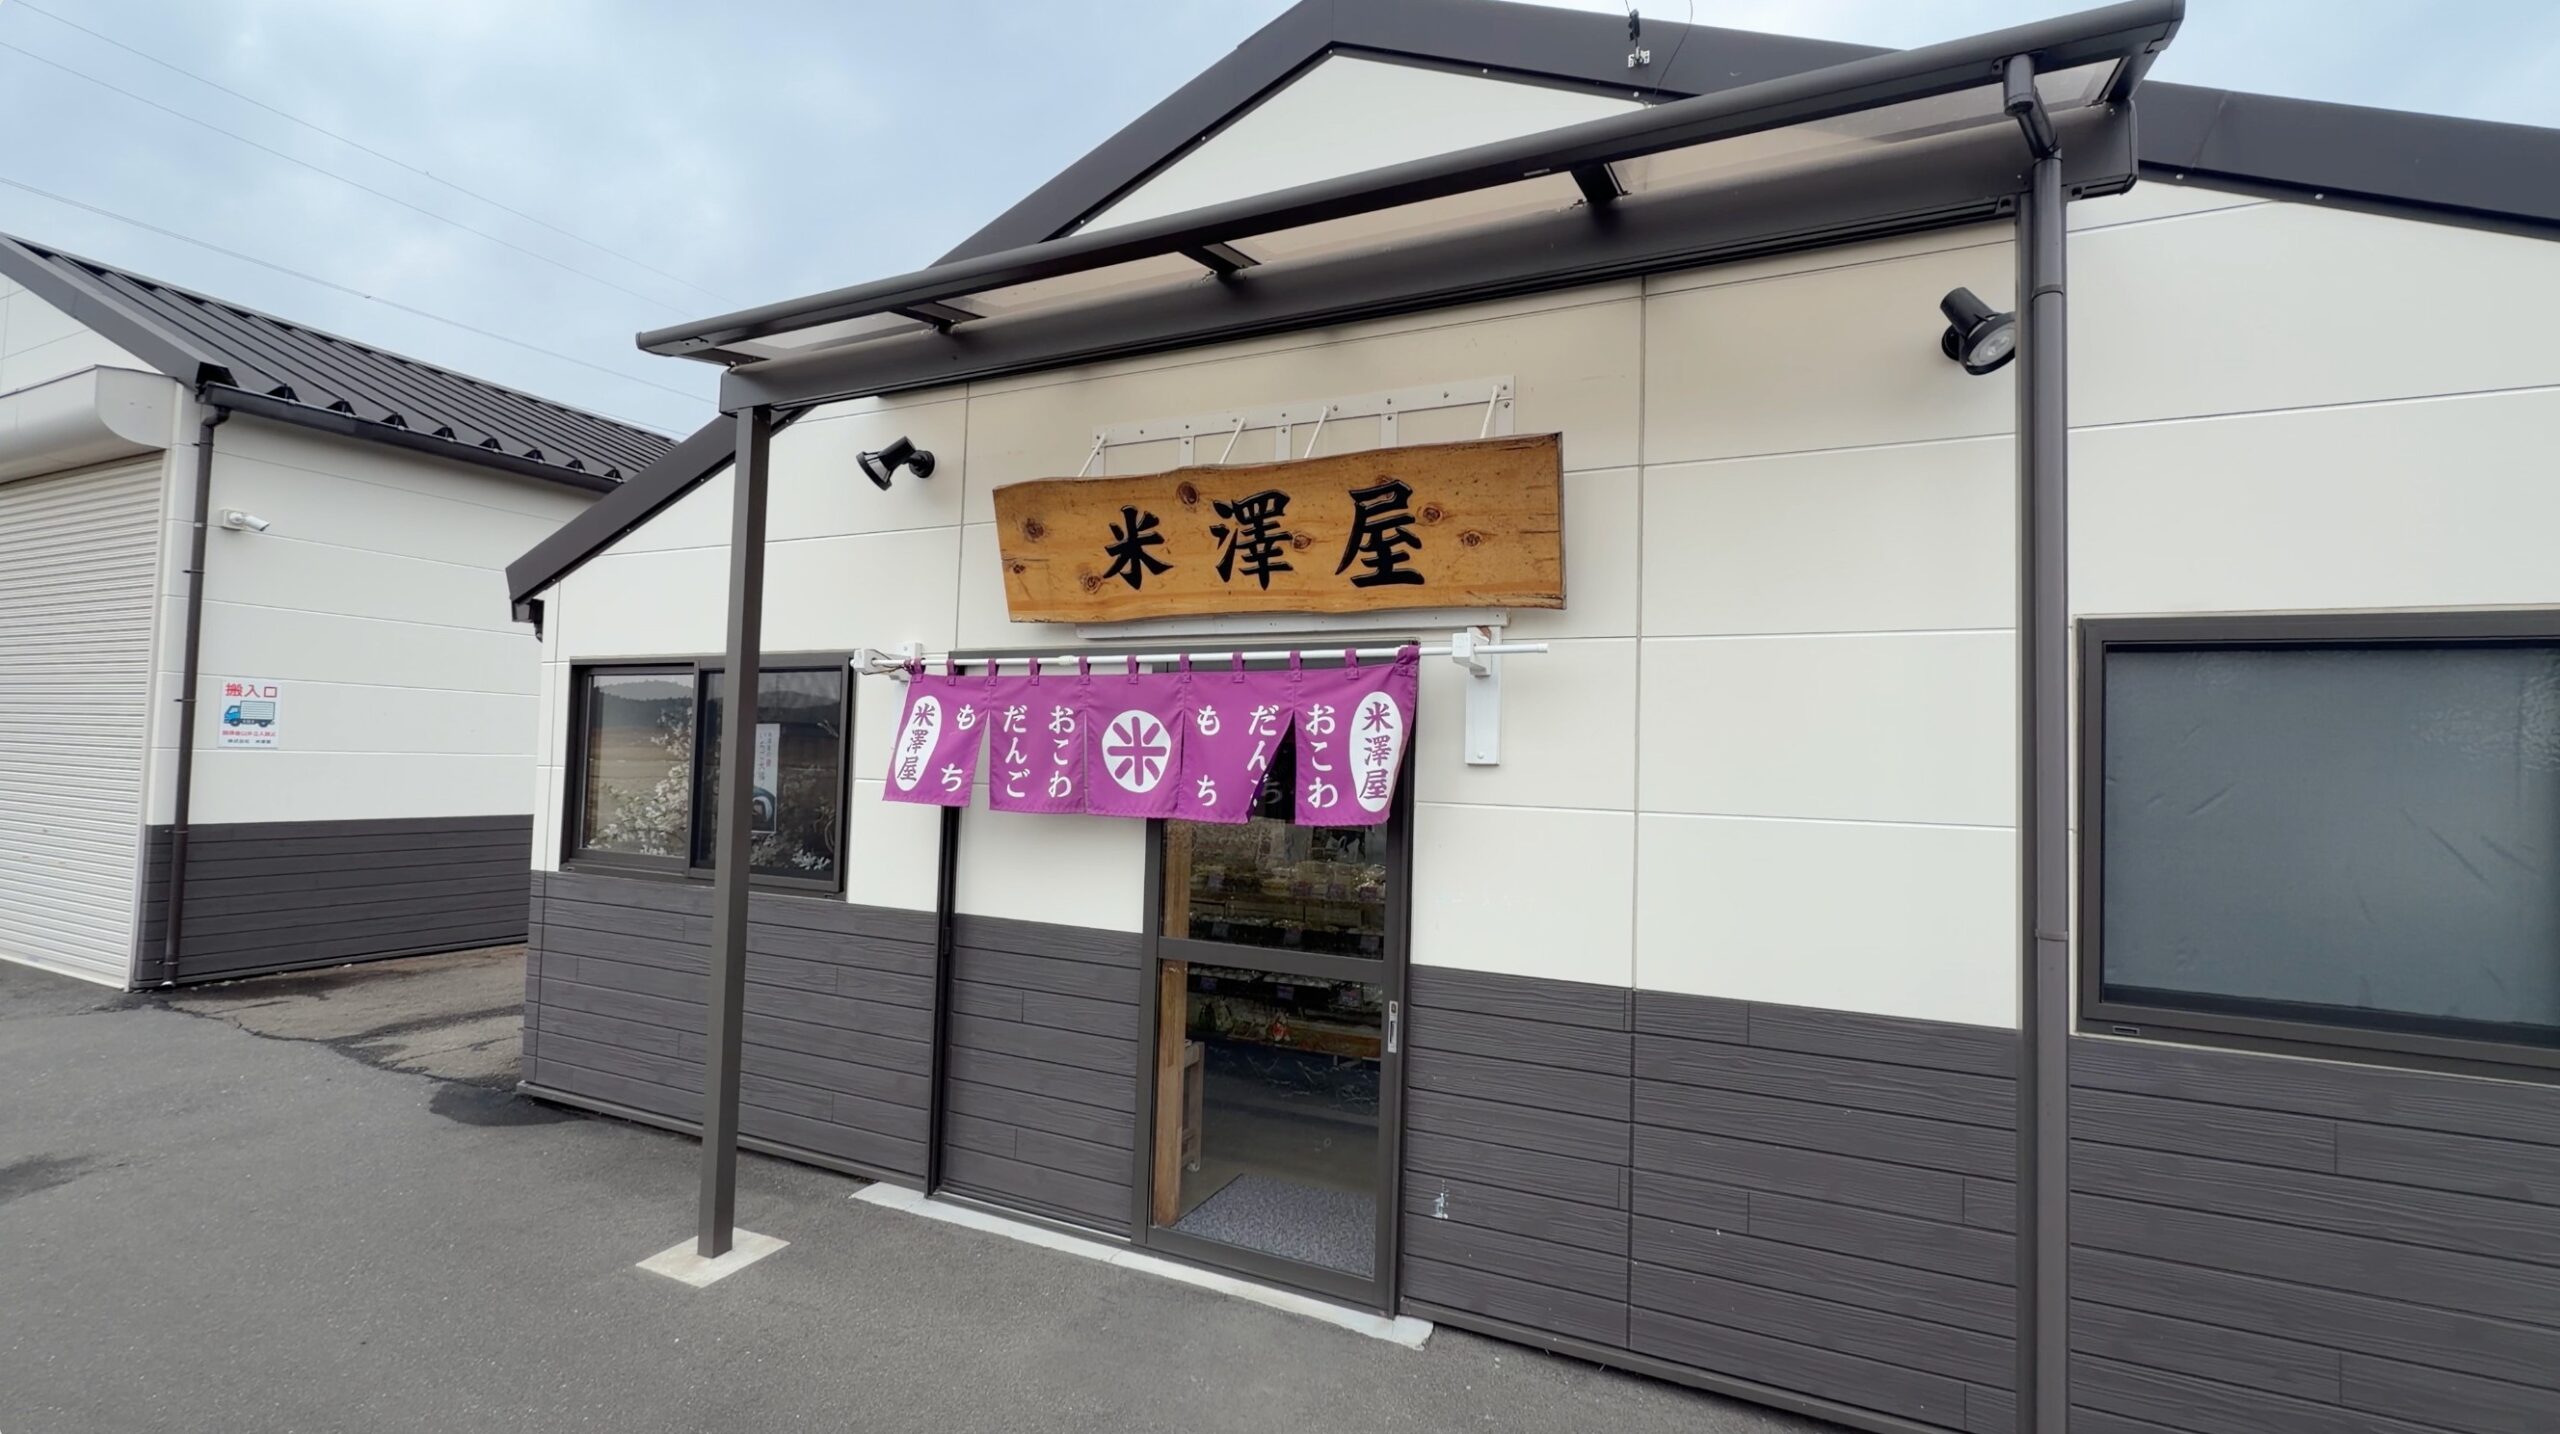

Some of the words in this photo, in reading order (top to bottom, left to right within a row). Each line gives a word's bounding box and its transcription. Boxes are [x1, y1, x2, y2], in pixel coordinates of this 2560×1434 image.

[1103, 479, 1425, 590] 米澤屋
[225, 683, 278, 698] 搬入口
[896, 702, 936, 783] 米澤屋
[940, 703, 976, 792] もち
[1003, 704, 1031, 798] だんご
[1048, 704, 1076, 798] おこわ
[1196, 704, 1221, 807] もち
[1246, 704, 1280, 807] だん
[1305, 703, 1339, 809] おこわ
[1358, 701, 1395, 800] 米澤屋
